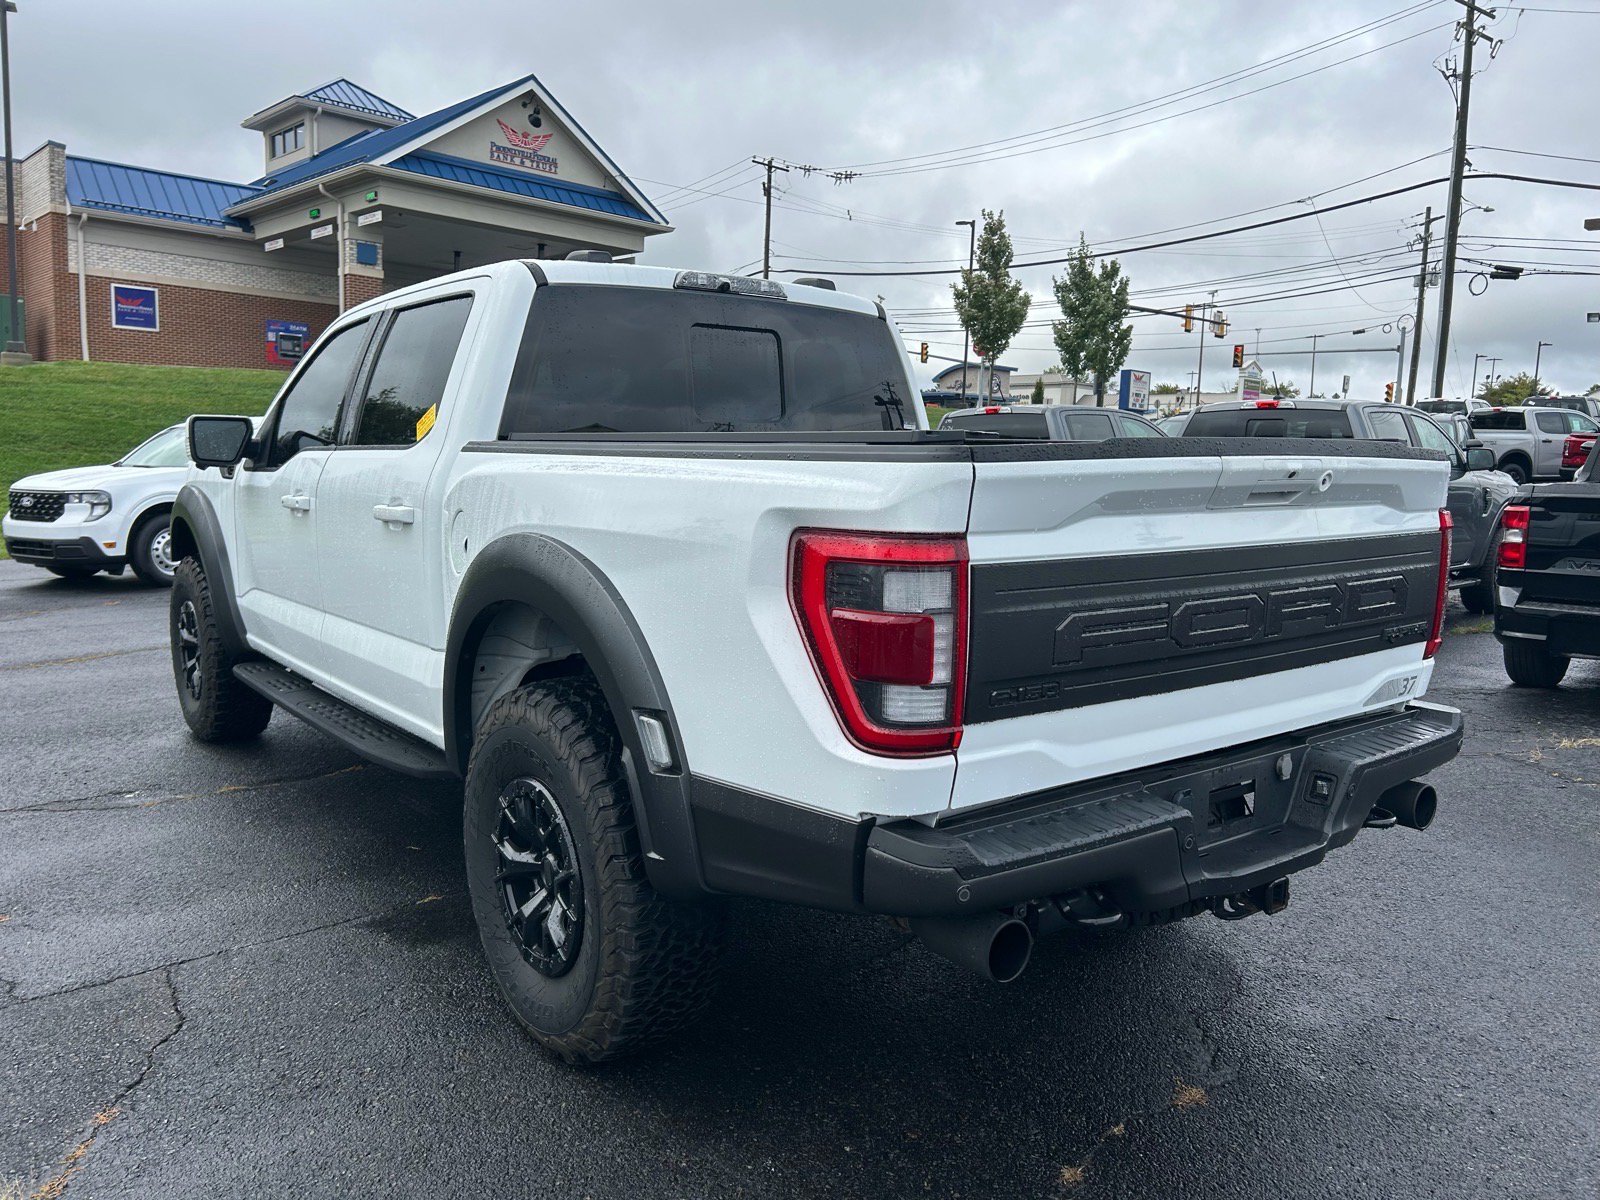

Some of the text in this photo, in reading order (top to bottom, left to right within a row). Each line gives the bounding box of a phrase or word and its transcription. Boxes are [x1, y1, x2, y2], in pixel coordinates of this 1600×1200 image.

[490, 151, 558, 173] BANK & TRUST
[1052, 575, 1409, 666] FORD
[988, 681, 1061, 707] F-150
[1398, 676, 1417, 696] 37
